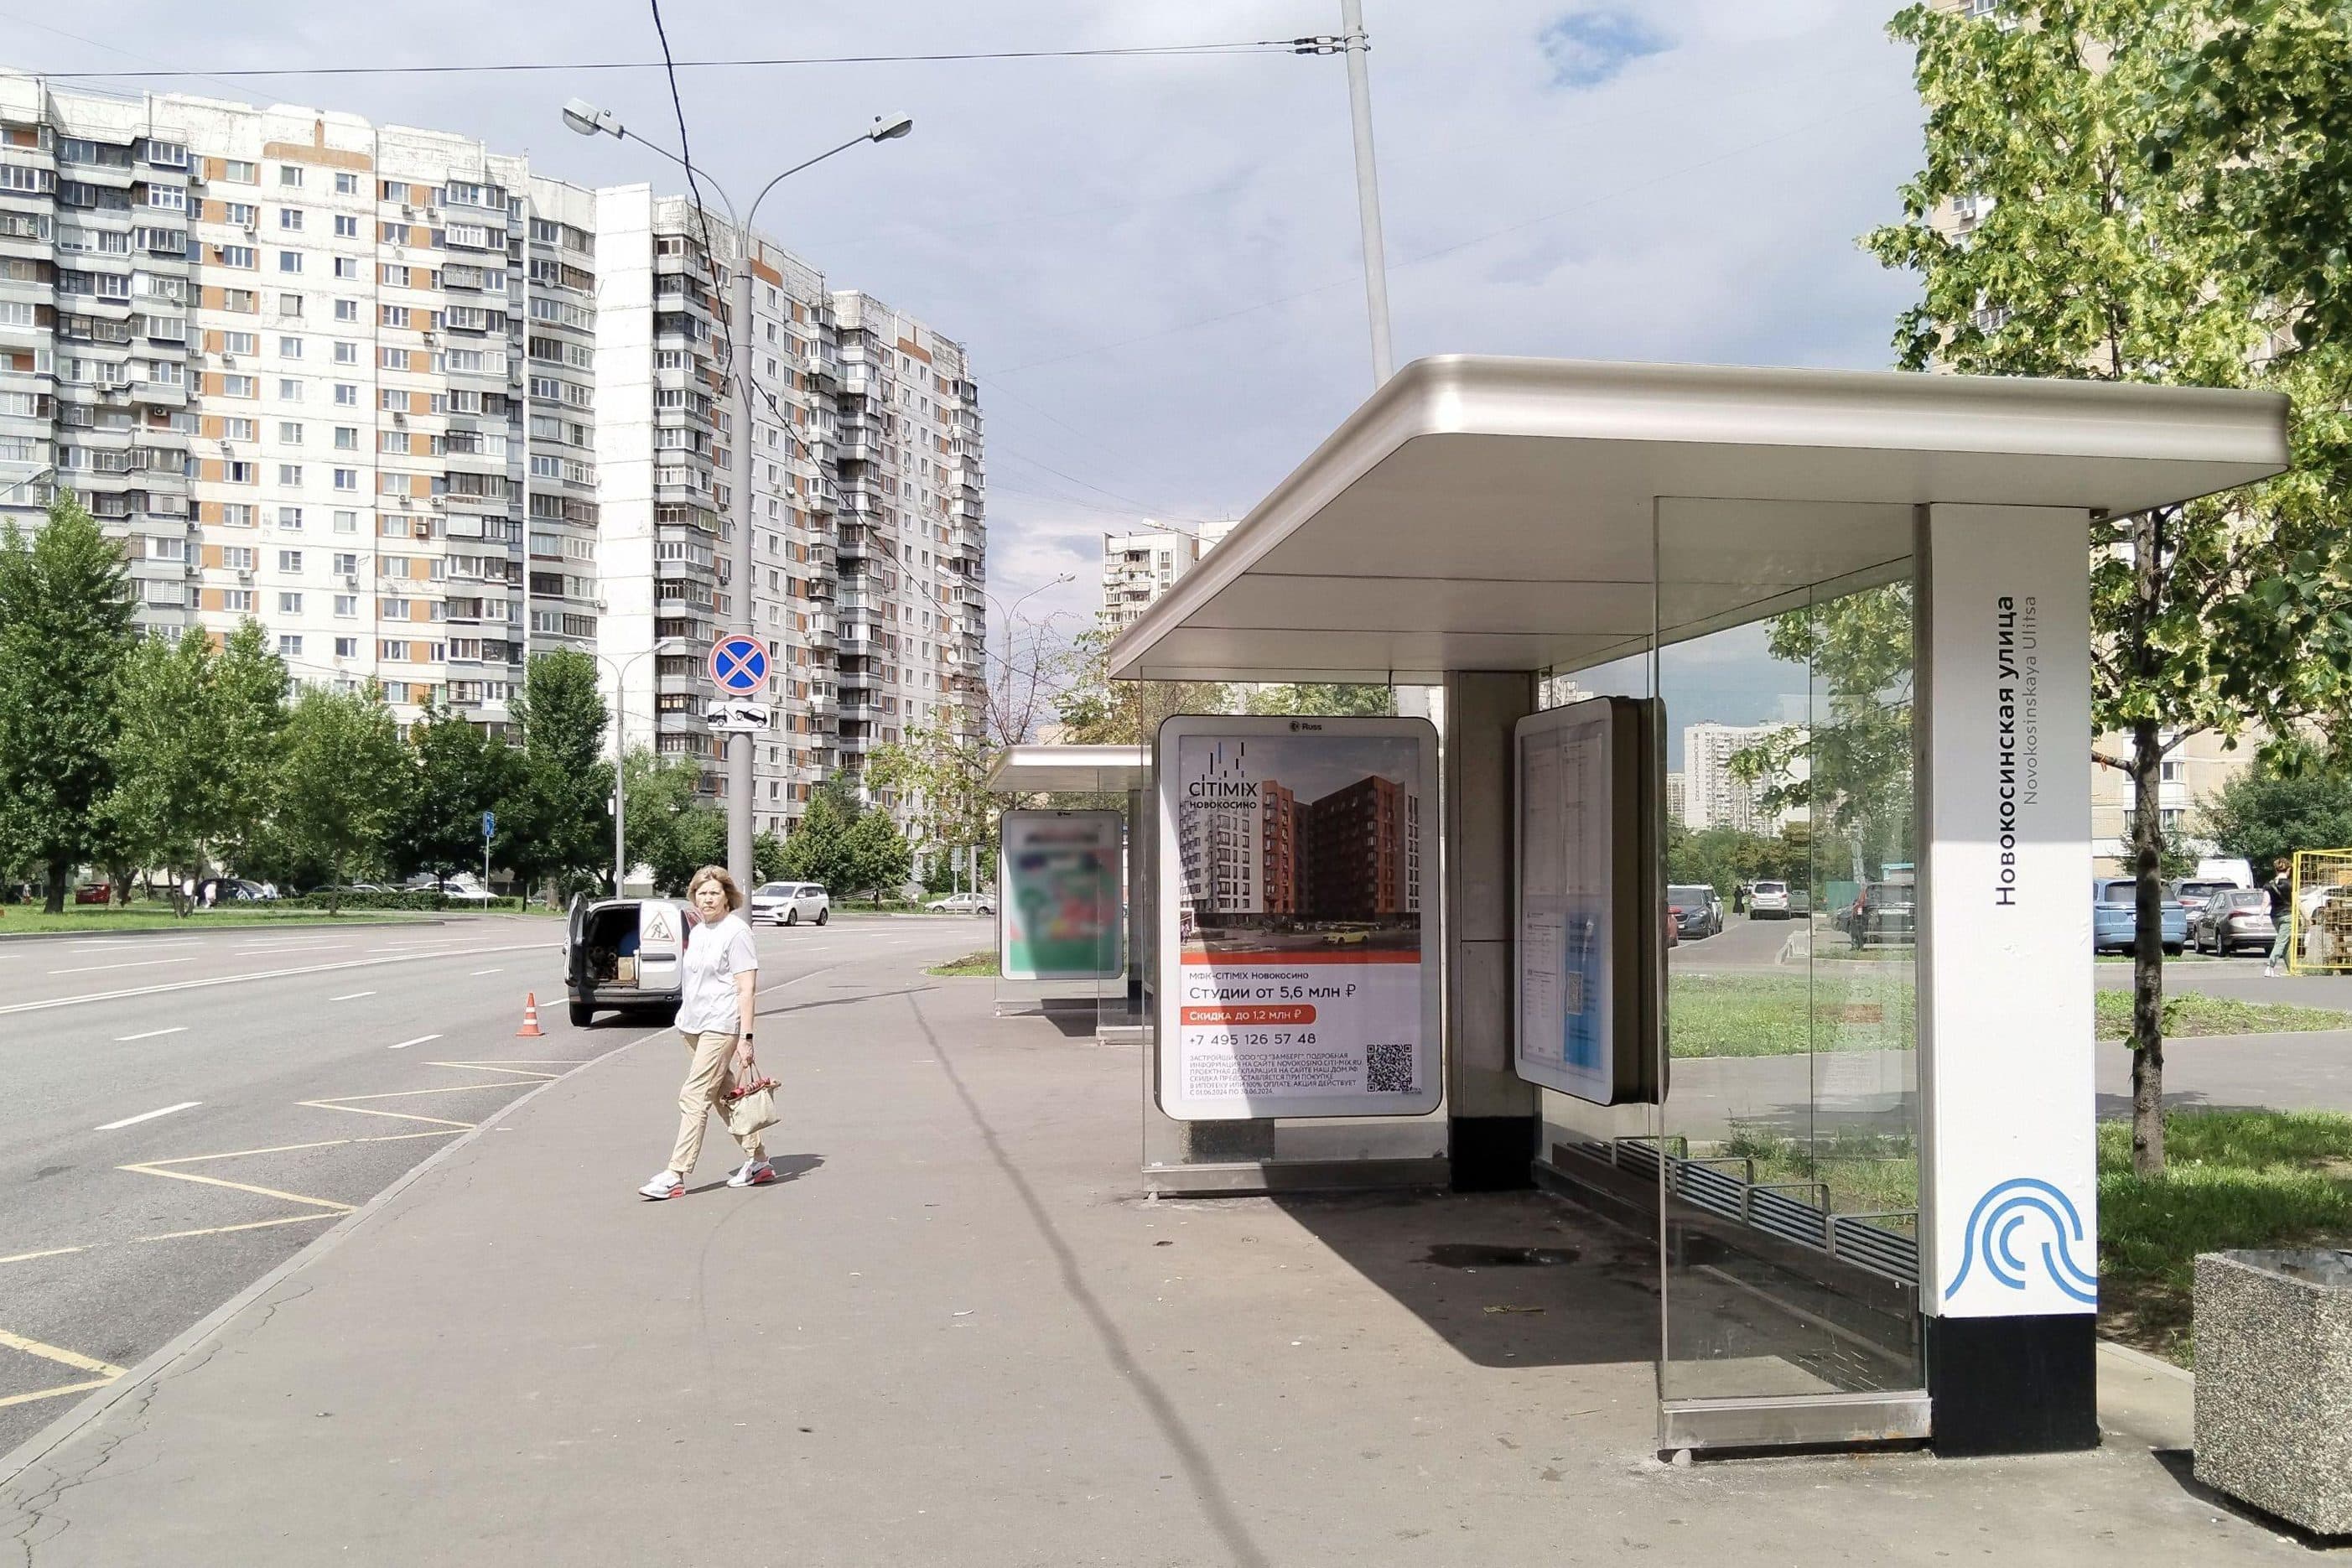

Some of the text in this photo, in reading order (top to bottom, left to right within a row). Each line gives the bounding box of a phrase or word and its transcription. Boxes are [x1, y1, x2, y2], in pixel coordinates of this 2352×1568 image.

[2021, 596, 2040, 805] Novokosinskaya Ulitsa
[1301, 722, 1322, 731] Russ
[1996, 596, 2019, 906] Новокосинская улица
[1189, 801, 1257, 809] НОВОКОСИНО
[1189, 984, 1356, 1000] Студии от 5,6 млн ₽
[1189, 1011, 1232, 1021] Скидка
[1235, 1011, 1249, 1020] до
[1269, 1011, 1290, 1020] млн
[1294, 1009, 1301, 1019] ₽
[1190, 1032, 1316, 1045] +7 495 126 57 48
